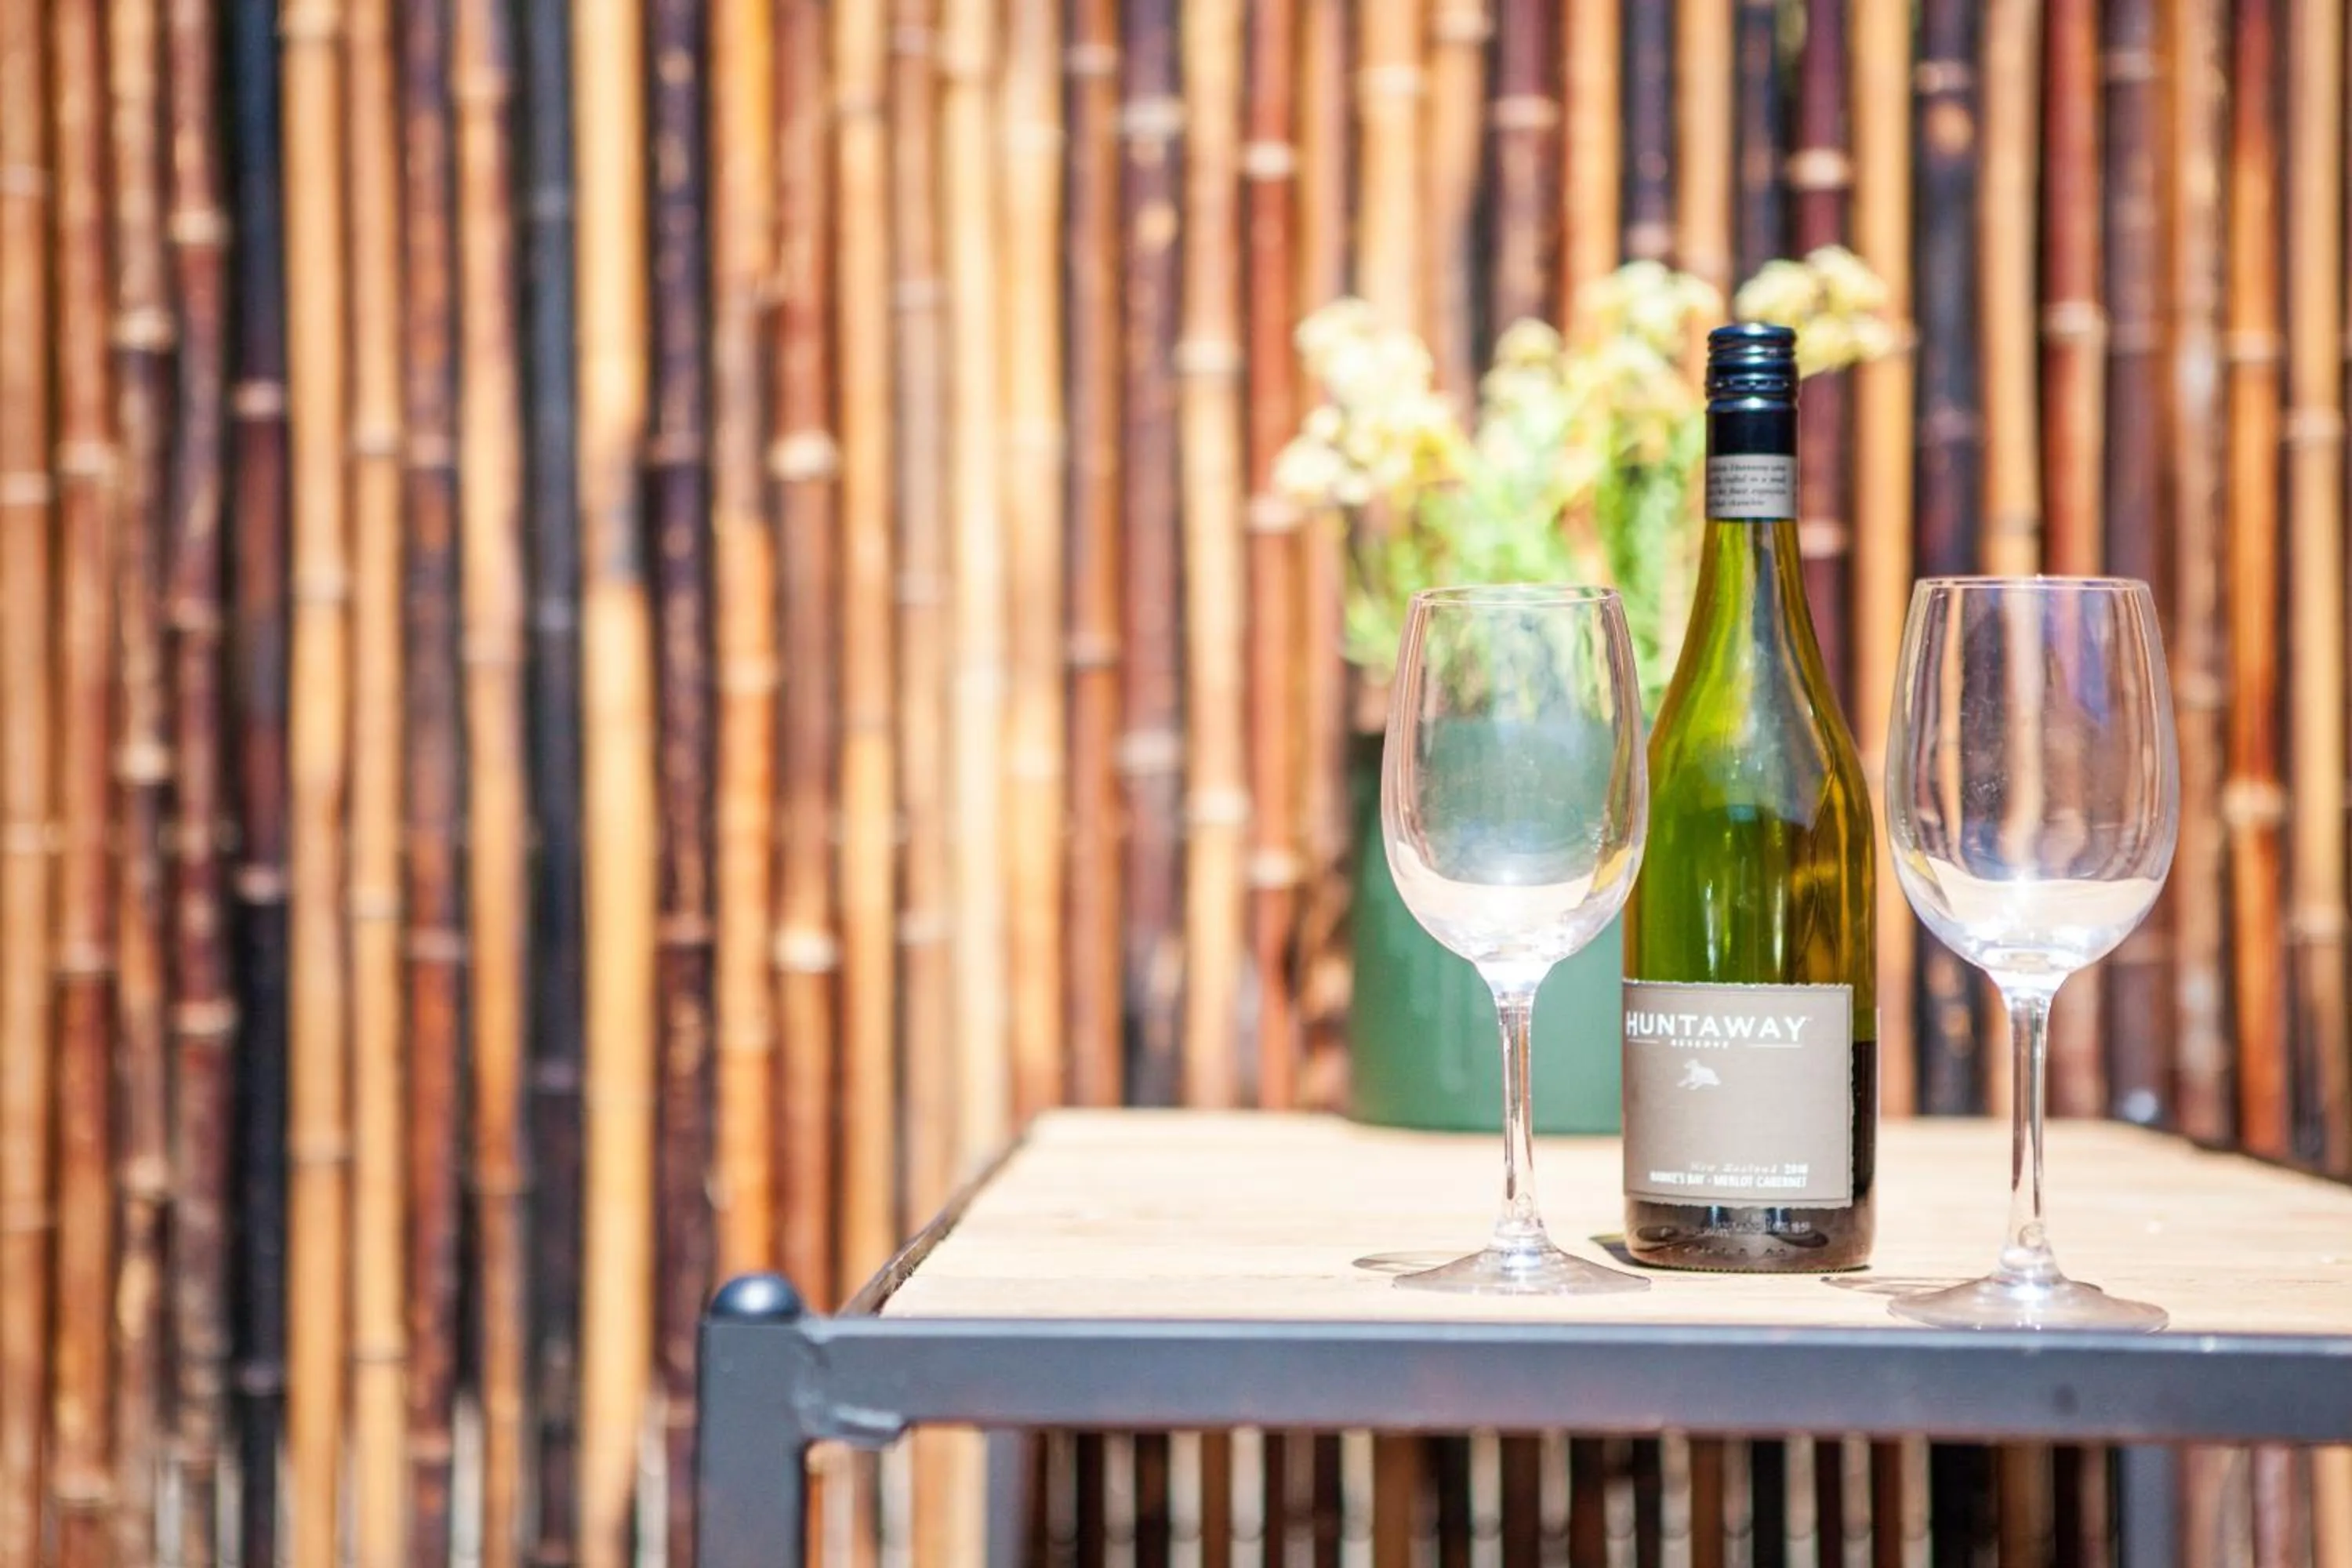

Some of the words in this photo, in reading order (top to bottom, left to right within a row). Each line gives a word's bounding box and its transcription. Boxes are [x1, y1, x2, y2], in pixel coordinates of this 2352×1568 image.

[1626, 1011, 1807, 1041] HUNTAWAY
[1714, 1174, 1753, 1187] MERLOT
[1756, 1175, 1806, 1189] CABERNET
